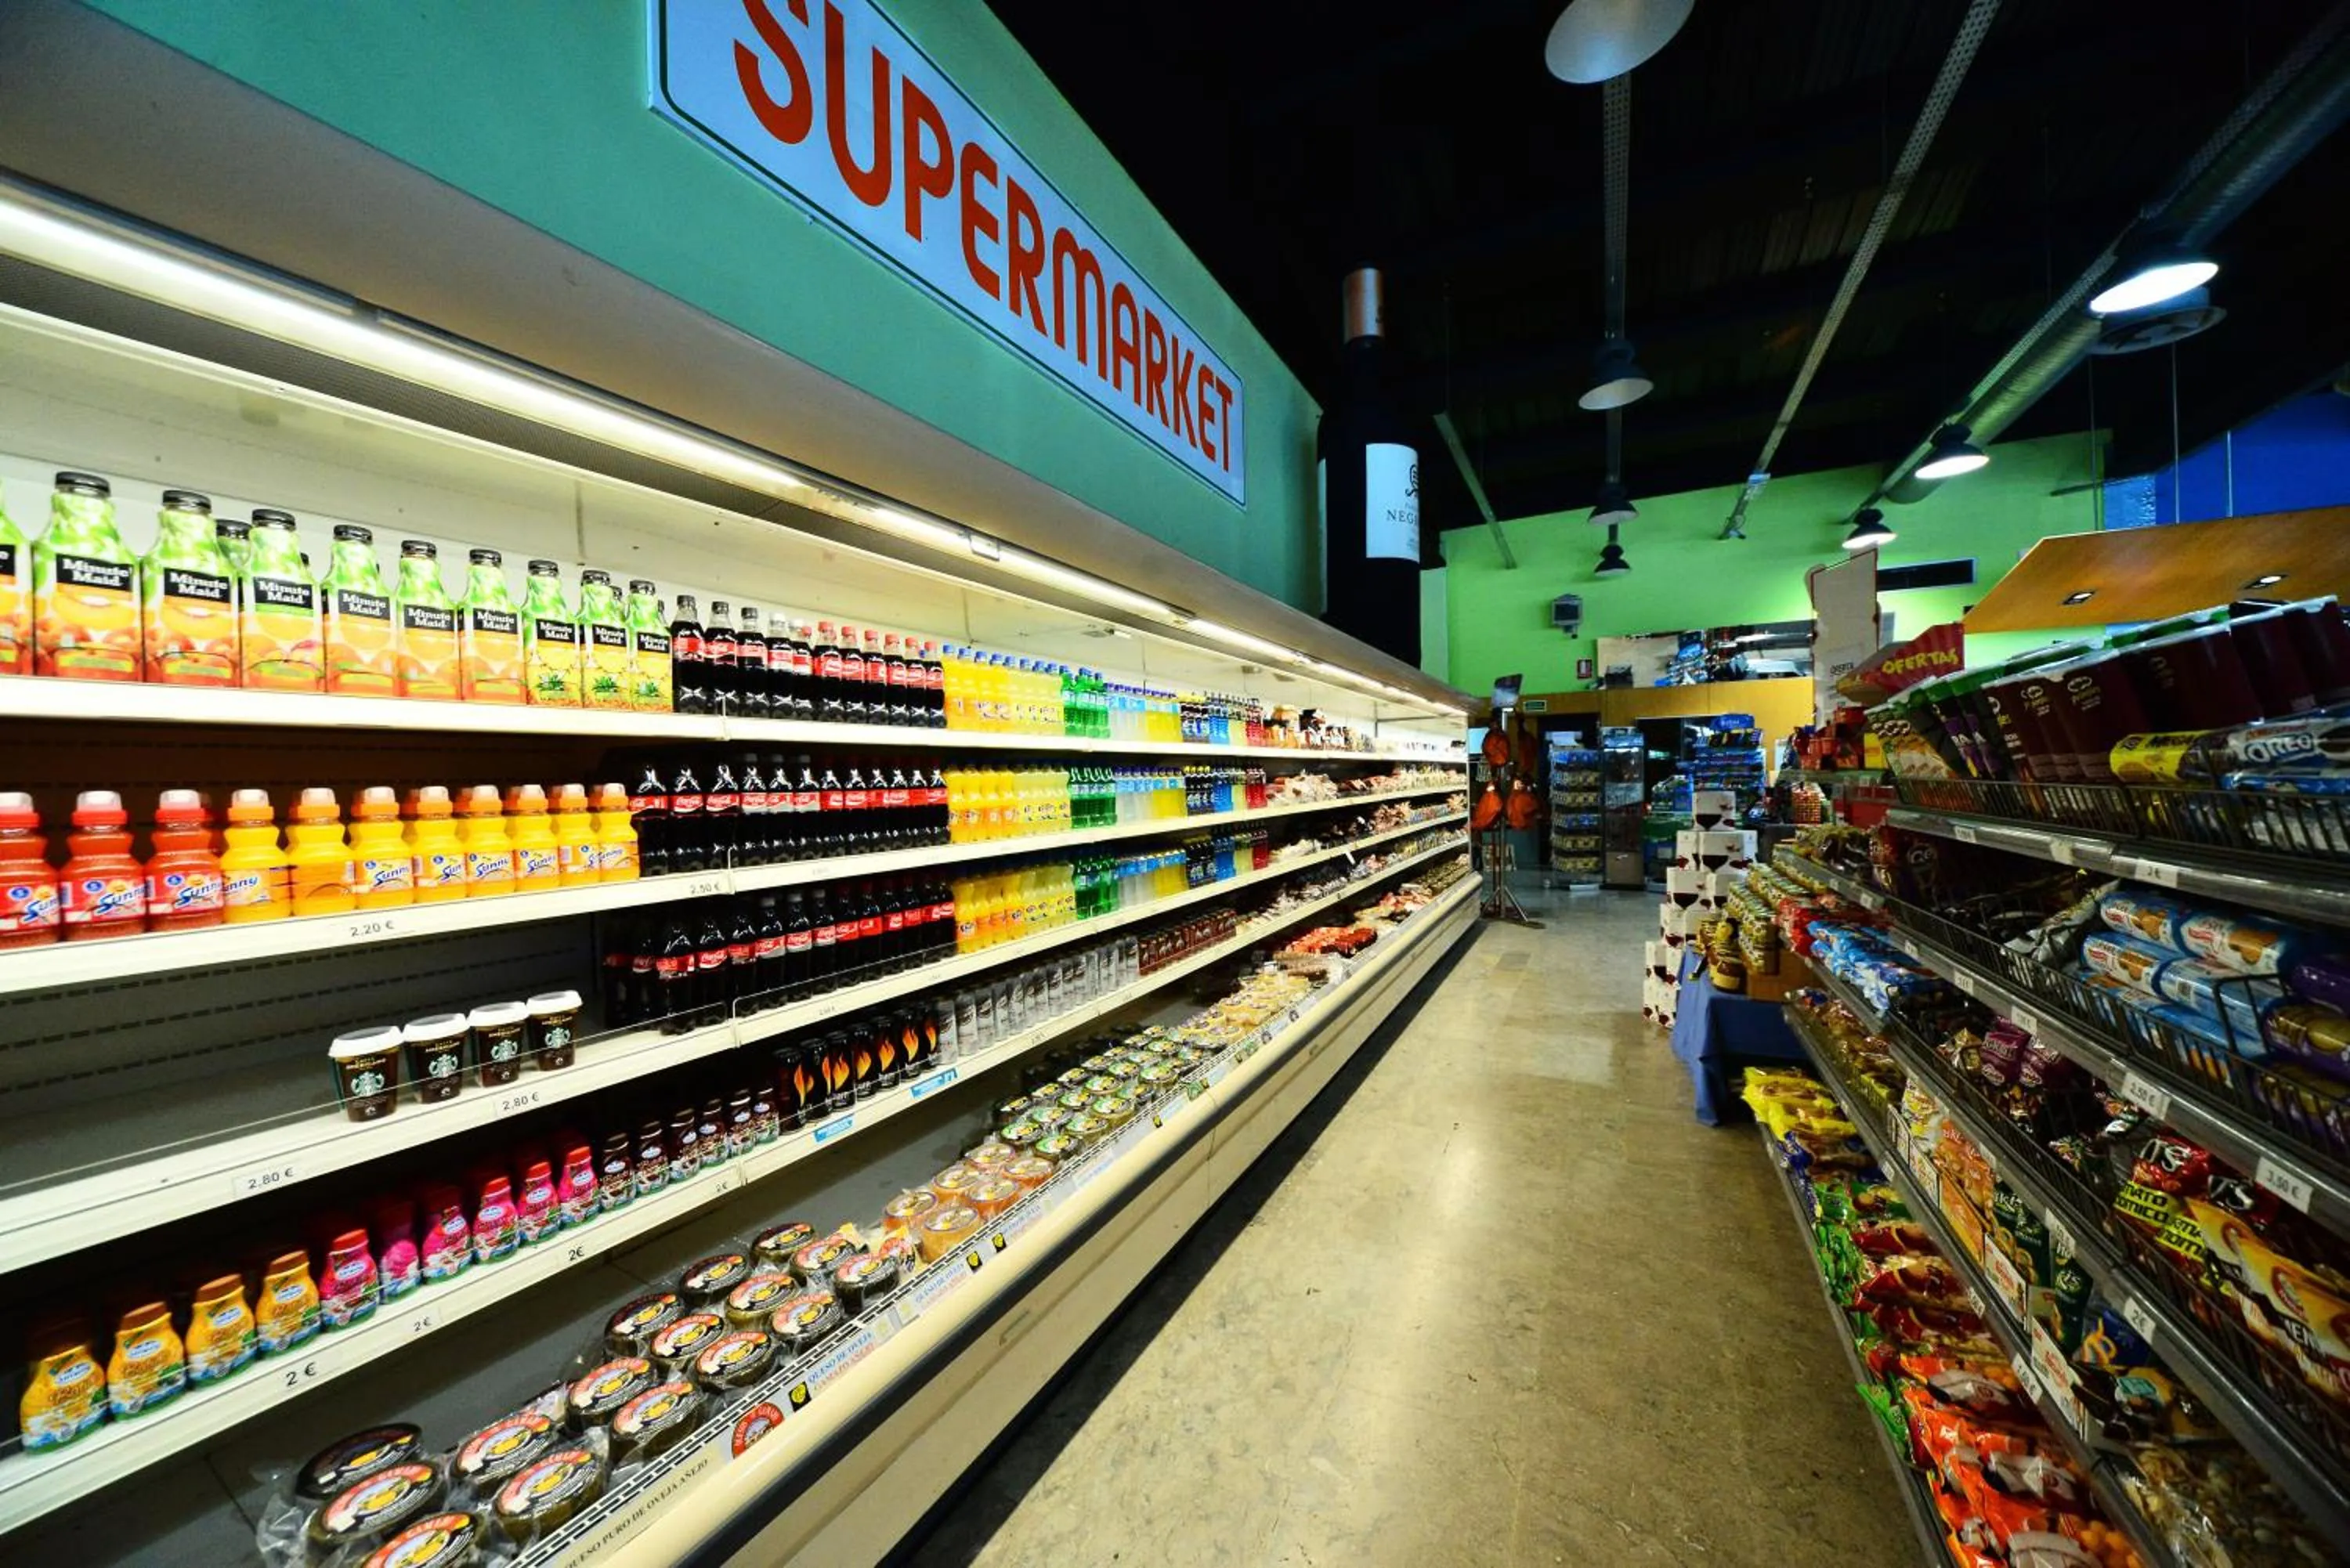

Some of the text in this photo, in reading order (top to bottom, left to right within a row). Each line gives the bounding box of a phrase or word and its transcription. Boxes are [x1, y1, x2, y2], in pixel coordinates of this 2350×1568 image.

[734, 0, 1233, 473] SUPERMARKET
[63, 558, 129, 578] Minute
[72, 569, 122, 587] Maid
[170, 572, 229, 591] Minute
[178, 582, 222, 600] Maid
[259, 580, 310, 596] Minute
[266, 590, 306, 605] Maid
[342, 593, 387, 609] Minute
[348, 602, 382, 617] Maid
[407, 607, 451, 622] Minute
[476, 609, 515, 625] Minute
[414, 616, 448, 628] Maid
[482, 619, 511, 631] Maid
[539, 620, 573, 634] Minute
[544, 628, 569, 641] Maid
[1882, 649, 1958, 674] OFERTAS
[2245, 734, 2312, 763] OREO
[286, 1361, 316, 1386] 2 €
[602, 1518, 631, 1545] PURO
[632, 1505, 646, 1522] DE
[646, 1483, 678, 1510] OVEJA
